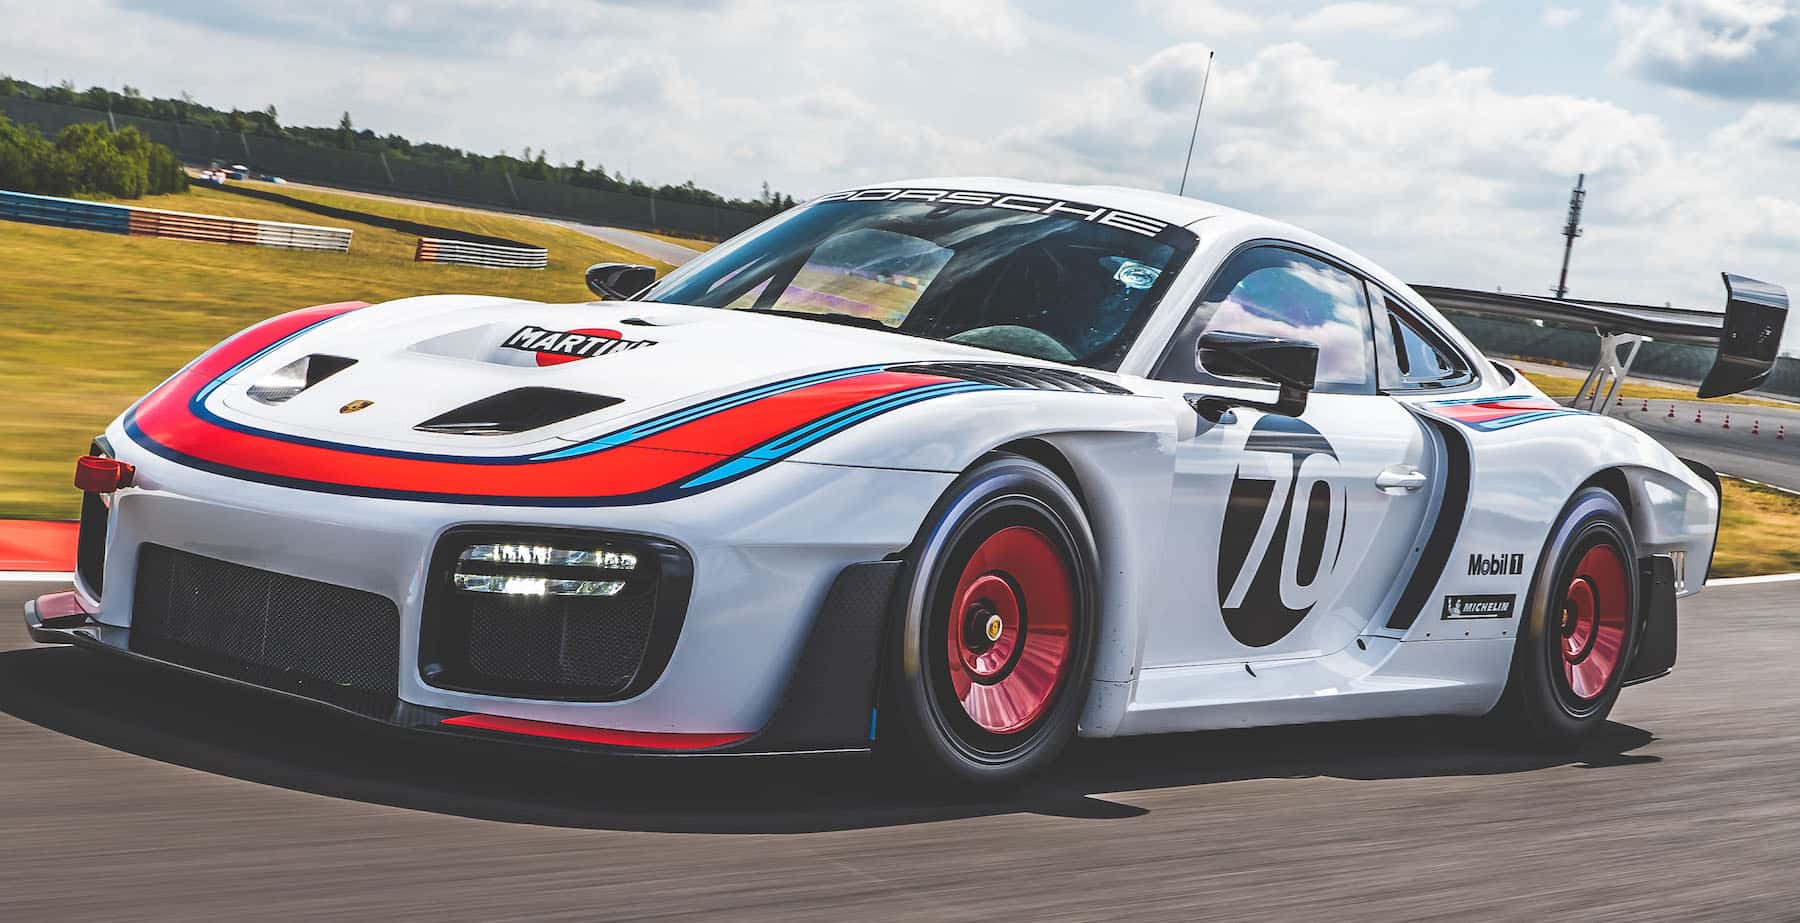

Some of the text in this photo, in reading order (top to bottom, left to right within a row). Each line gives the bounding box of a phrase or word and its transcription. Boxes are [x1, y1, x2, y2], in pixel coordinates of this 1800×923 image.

[816, 188, 1169, 238] PORSCHE
[1222, 449, 1347, 610] 70
[1467, 553, 1508, 576] Mobil
[1462, 601, 1510, 612] MICHELIN
